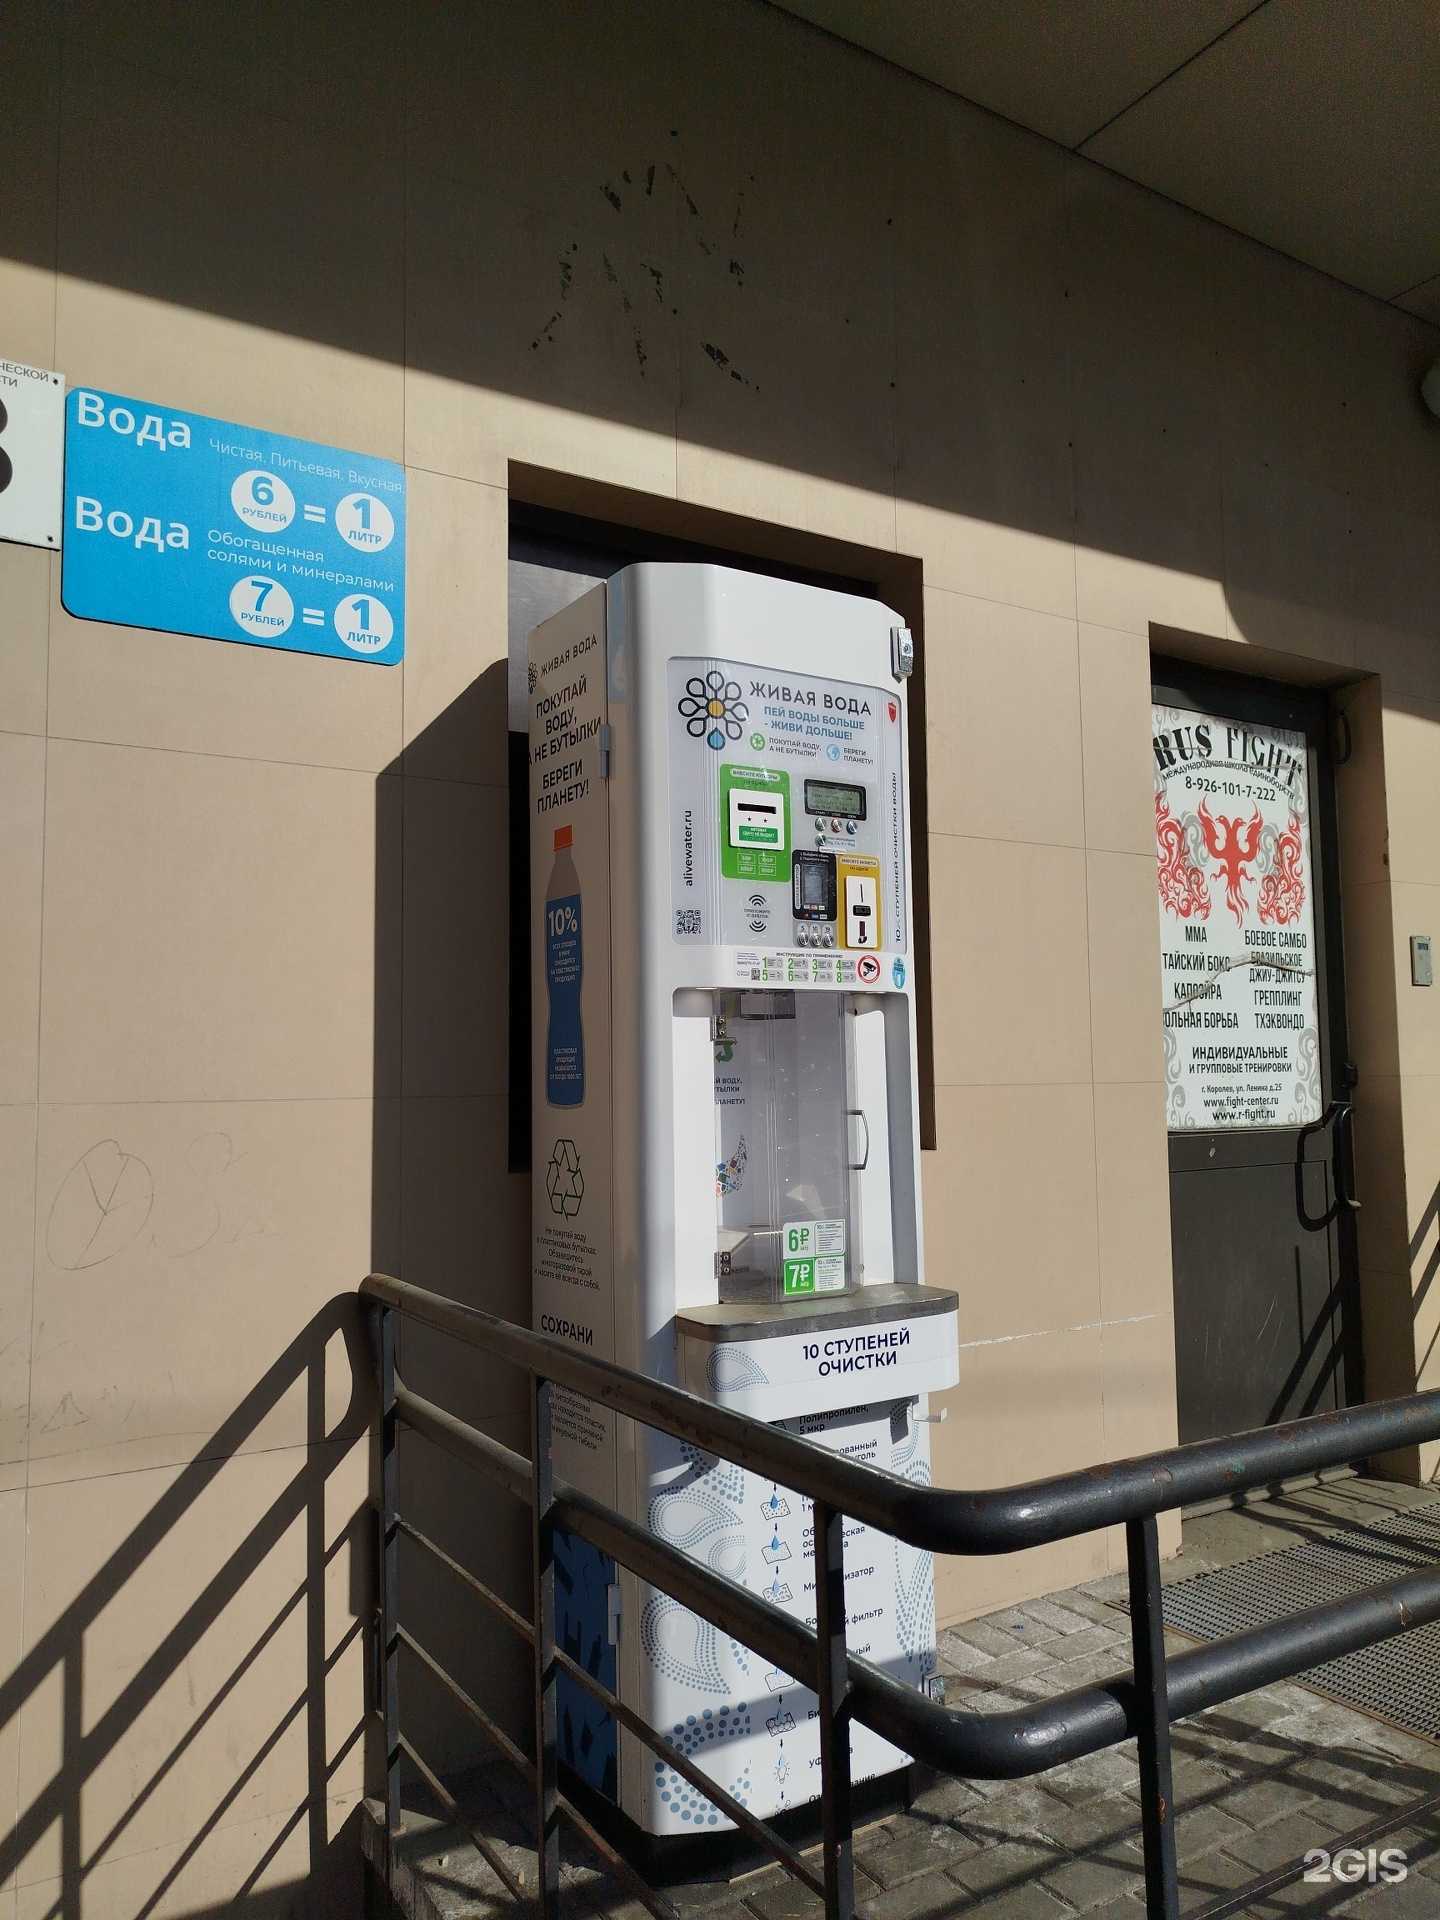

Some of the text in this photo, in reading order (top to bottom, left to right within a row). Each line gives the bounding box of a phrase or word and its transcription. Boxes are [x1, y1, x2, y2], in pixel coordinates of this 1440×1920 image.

[77, 391, 192, 451] Вода
[242, 506, 287, 523] РУБЛЕЙ
[251, 476, 275, 506] 6
[352, 497, 373, 530] 1
[75, 496, 190, 553] Вода
[208, 529, 324, 563] Обогащенная
[347, 529, 382, 545] ЛИТР
[208, 549, 394, 592] солями и минералами
[250, 580, 273, 612] 7
[351, 598, 371, 630] 1
[241, 611, 285, 627] РУБЛЕЙ
[347, 631, 381, 646] ЛИТР
[541, 634, 598, 677] ЖИВАЯ ВОДА
[536, 675, 587, 719] ПОКУПАЙ
[750, 681, 872, 716] ЖИВАЯ ВОДА
[545, 707, 577, 736] ВОДУ,
[764, 706, 865, 730] ПЕЙ ВОДЫ БОЛЬШЕ
[534, 743, 548, 763] НЕ
[550, 717, 601, 755] БУТЫЛКИ
[770, 720, 803, 733] ЖИВИ
[805, 725, 853, 741] ДОЛЬШЕ!
[1153, 724, 1212, 771] RUS
[542, 759, 583, 790] БЕРЕГИ
[537, 779, 590, 815] ПЛАНЕТУ!
[1185, 776, 1276, 801] 8-926-101-7-222
[683, 810, 692, 887] alivewater.ru
[549, 906, 577, 937] 10%
[1244, 929, 1307, 949] БОЕВОЕ САМБО
[762, 957, 767, 968] 1
[788, 958, 793, 969] 2
[812, 959, 818, 970] 3
[836, 960, 841, 970] 4
[1162, 951, 1231, 972] ТАЙСКИЙ БОКС
[762, 970, 842, 983] 5 6 7 8
[1250, 967, 1305, 984] ДЖИУ-ДЖИТСУ
[1254, 989, 1302, 1006] ГРЕППЛИНГ
[1163, 1012, 1239, 1029] ОЛЬНАЯ БОРЬБА
[1254, 1012, 1305, 1030] ТХЭКВОНДО
[1192, 1046, 1288, 1061] ИНДИВИДУАЛЬНЫЕ
[1189, 1062, 1292, 1074] И ГРУППОВЫЕ ТРЕНИРОВКИ
[1203, 1096, 1279, 1109] www.fight-center.ru
[1212, 1109, 1276, 1121] www.r-fight.ru
[541, 1314, 593, 1346] СОХРАНИ
[803, 1327, 910, 1360] 10 СТУПЕНЕЙ
[818, 1351, 897, 1377] ОЧИСТКИ
[807, 1423, 825, 1435] мкр
[852, 1608, 883, 1624] фильтр
